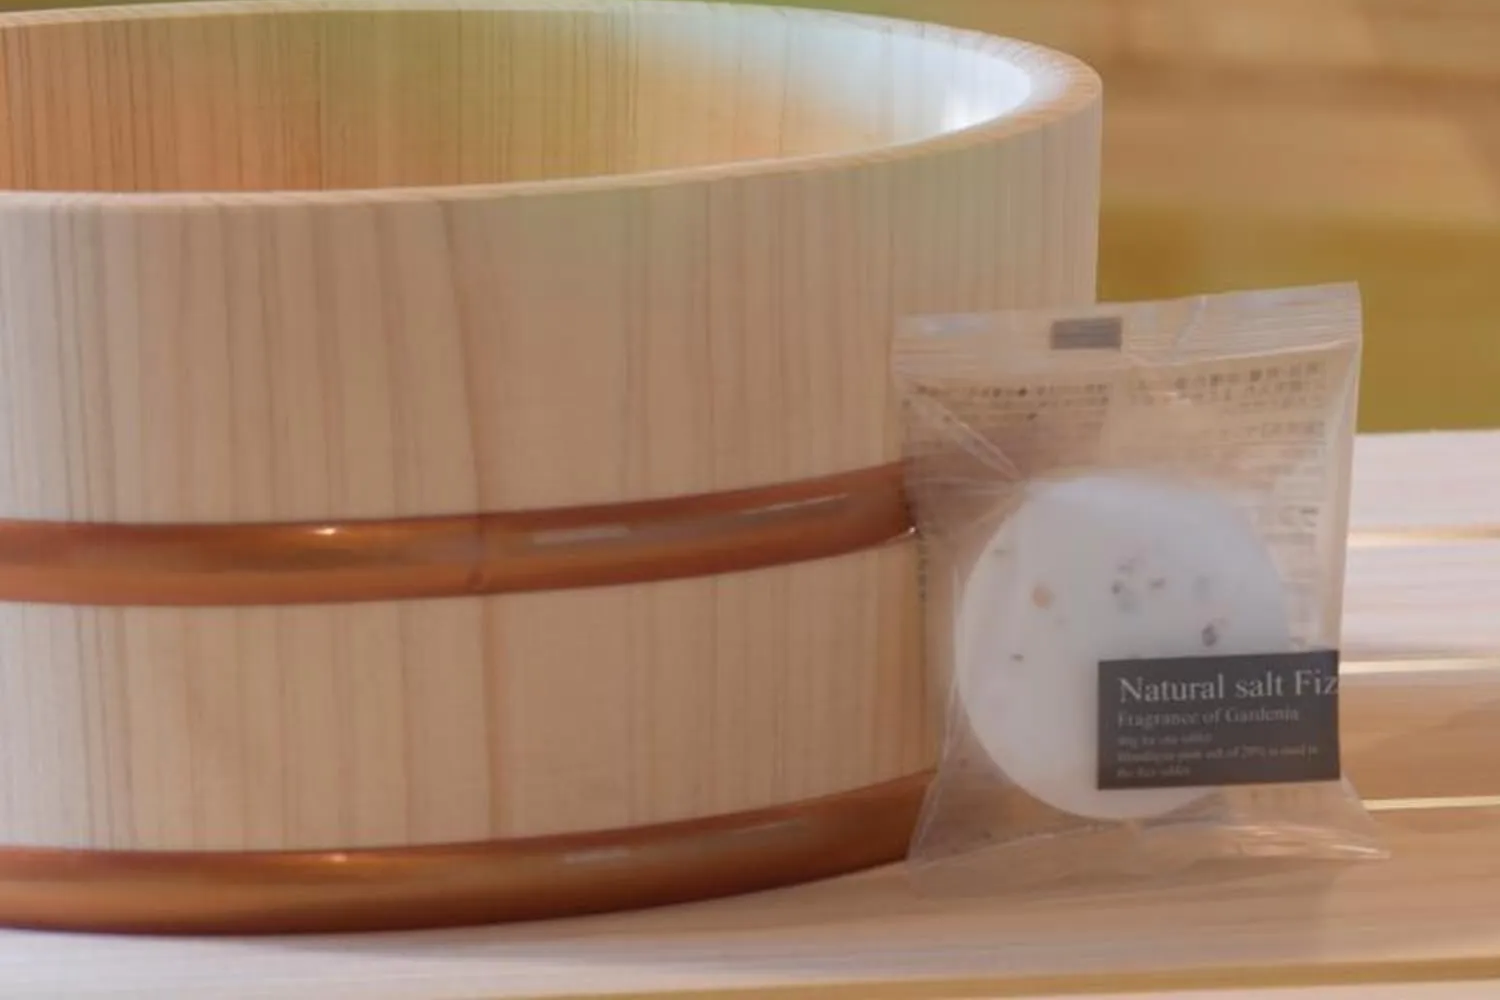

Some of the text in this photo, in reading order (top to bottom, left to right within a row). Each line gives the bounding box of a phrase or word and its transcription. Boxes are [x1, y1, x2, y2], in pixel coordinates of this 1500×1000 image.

[1118, 668, 1338, 703] Natural salt Fiz
[1202, 710, 1221, 724] of
